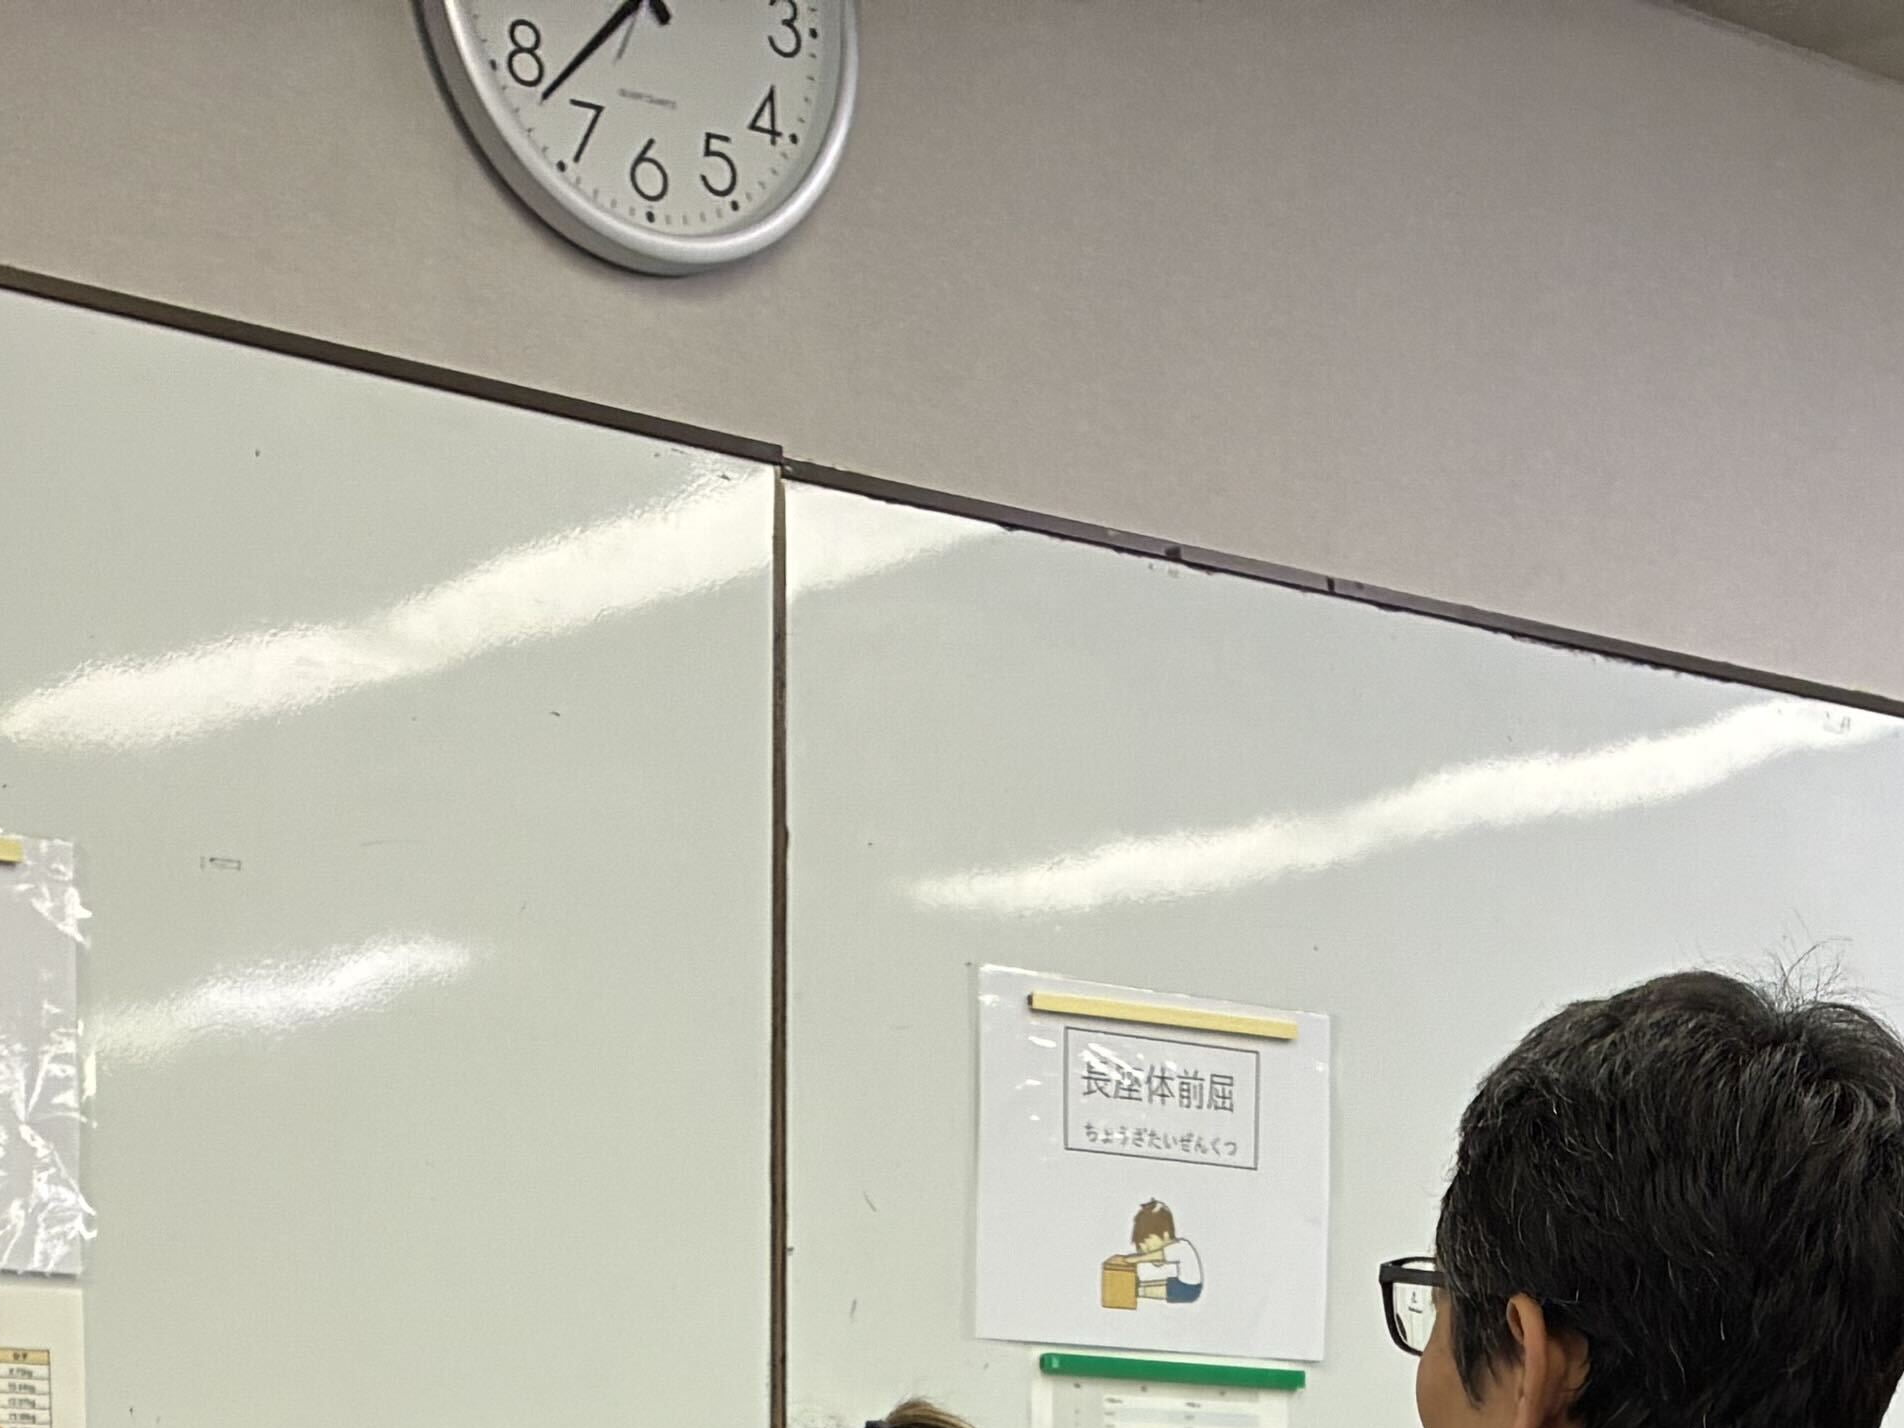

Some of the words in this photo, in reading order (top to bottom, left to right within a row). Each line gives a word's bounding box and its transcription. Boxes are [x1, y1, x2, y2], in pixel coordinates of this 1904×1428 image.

[506, 19, 545, 87] 8
[768, 0, 801, 58] 3
[569, 99, 605, 163] 7
[747, 85, 782, 145] 4
[629, 138, 669, 202] 6
[700, 132, 737, 197] 5
[1081, 1060, 1236, 1114] 長座体前屈
